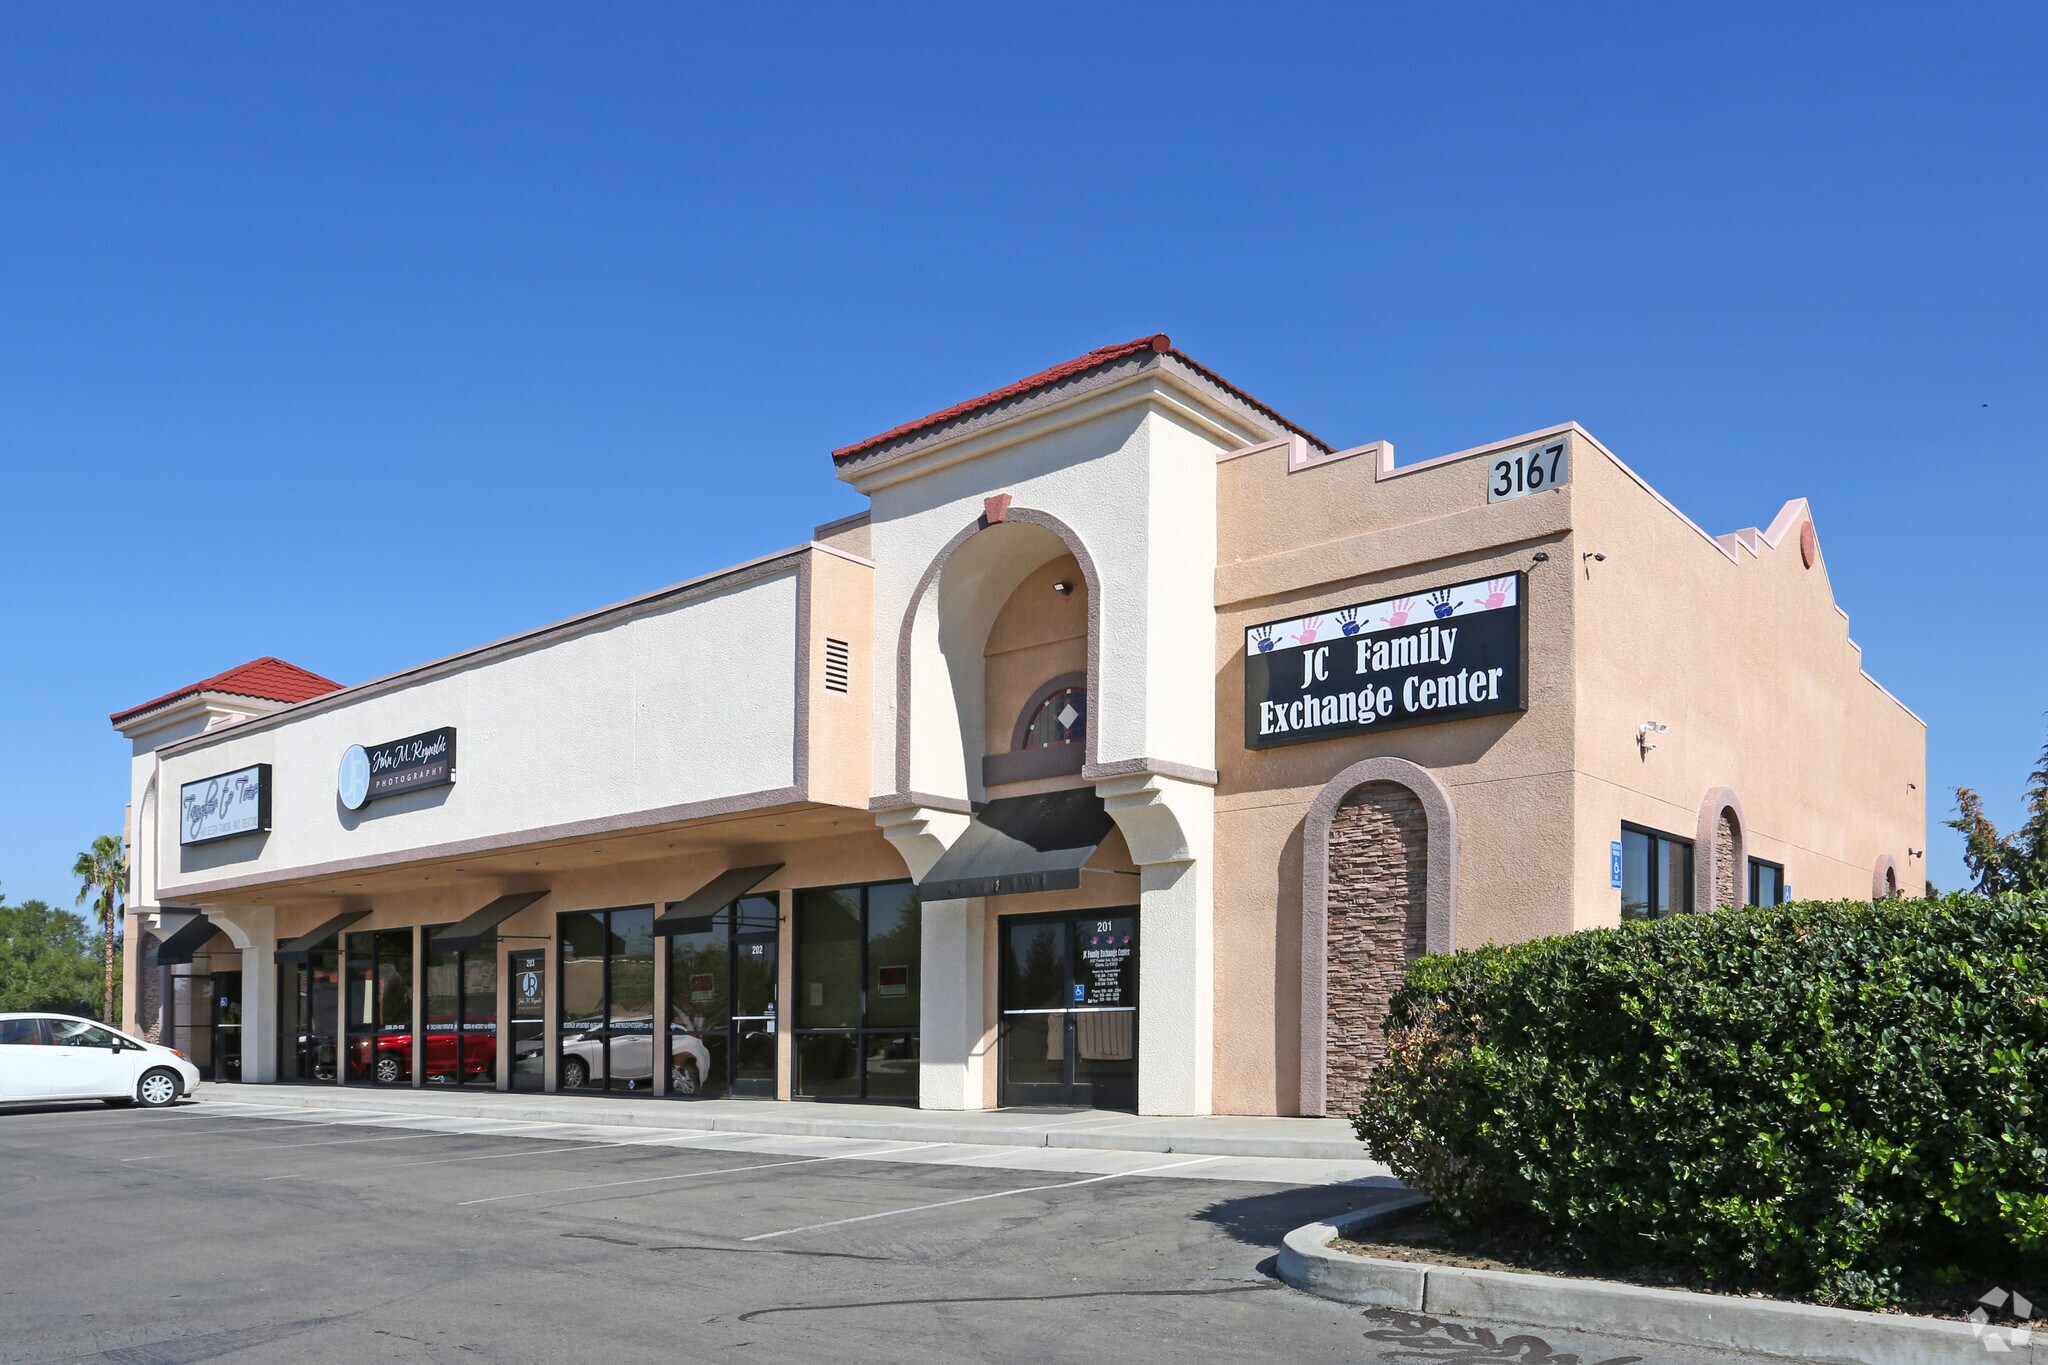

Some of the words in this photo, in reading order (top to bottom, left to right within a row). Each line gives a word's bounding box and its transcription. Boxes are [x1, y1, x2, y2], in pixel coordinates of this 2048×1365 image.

[1494, 444, 1563, 496] 3167
[1301, 646, 1329, 690] JC
[1356, 626, 1458, 675] Family
[1259, 682, 1393, 736] Exchange
[1403, 667, 1503, 713] Center
[373, 750, 393, 773] John
[411, 735, 447, 765] Reynolds
[376, 766, 443, 788] PHOTOGRAPHY
[1097, 921, 1112, 932] 201
[752, 945, 763, 954] 202
[1088, 950, 1100, 959] Family
[1100, 949, 1117, 958] Exchange
[1118, 948, 1130, 956] Center
[526, 959, 535, 967] 203
